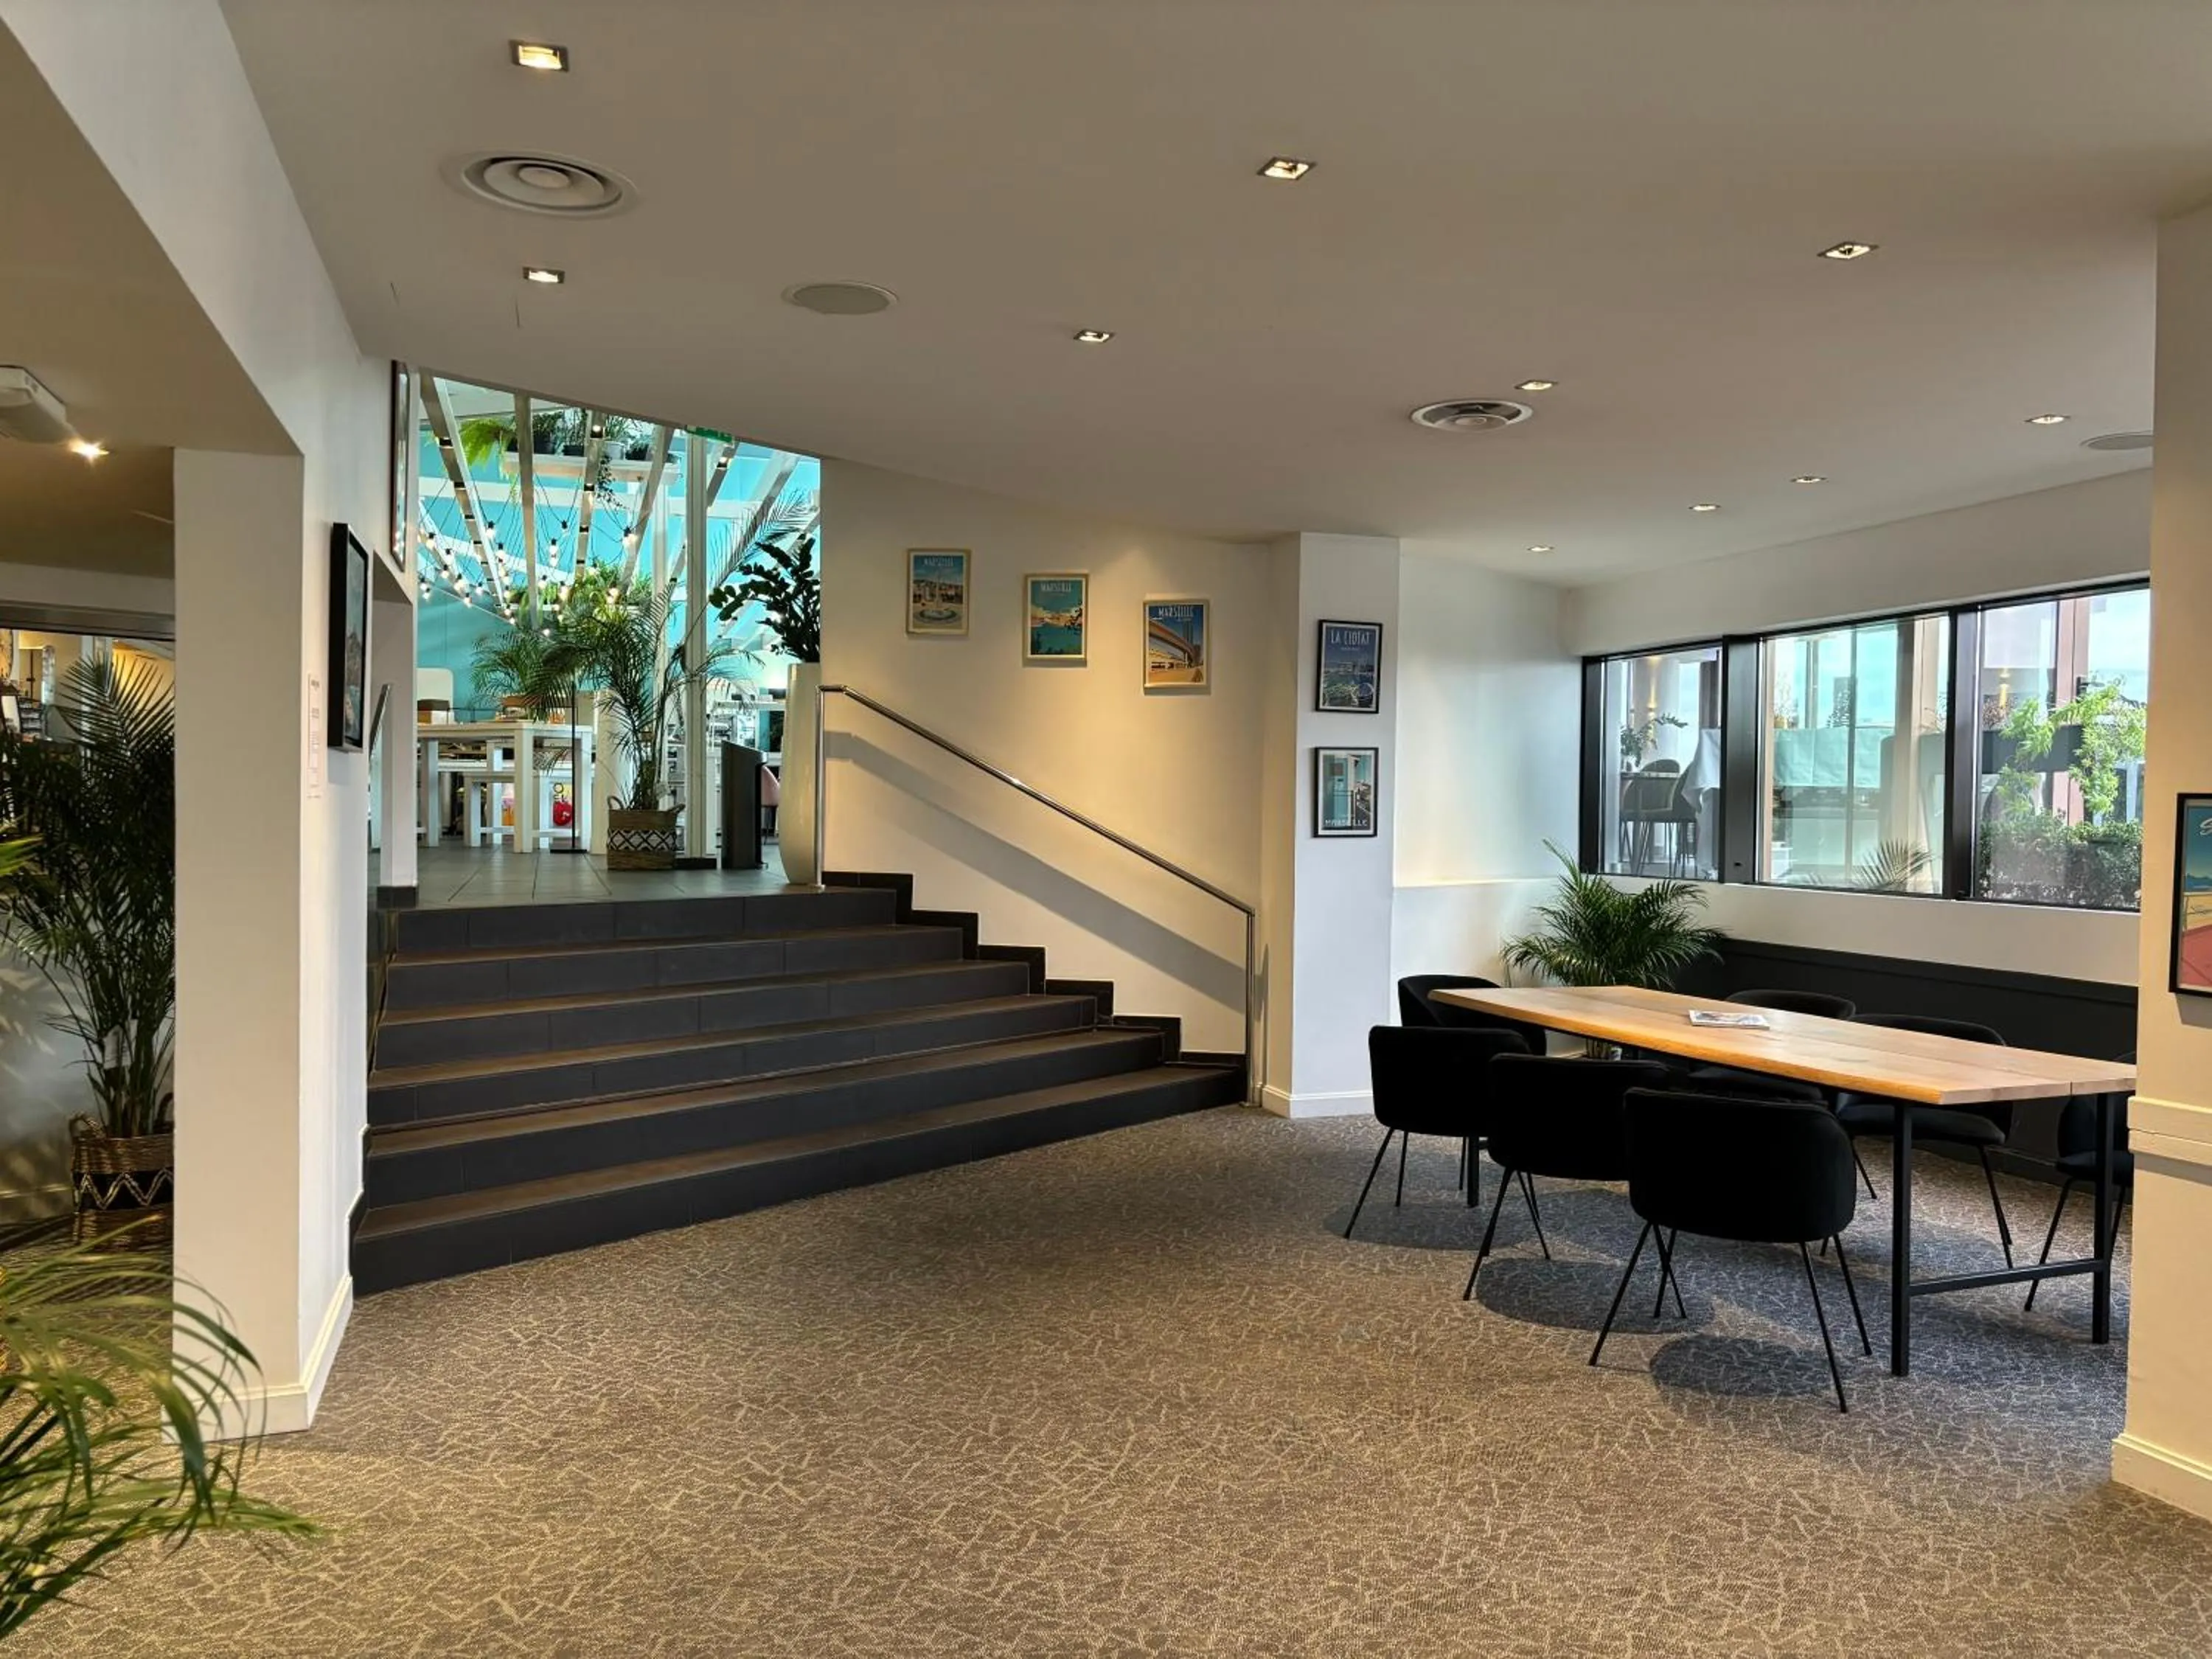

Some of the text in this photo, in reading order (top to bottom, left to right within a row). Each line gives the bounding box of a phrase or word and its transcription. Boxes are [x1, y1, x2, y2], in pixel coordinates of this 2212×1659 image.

[1158, 605, 1194, 618] MARSEILLE
[1331, 630, 1370, 645] LA CIOTAT
